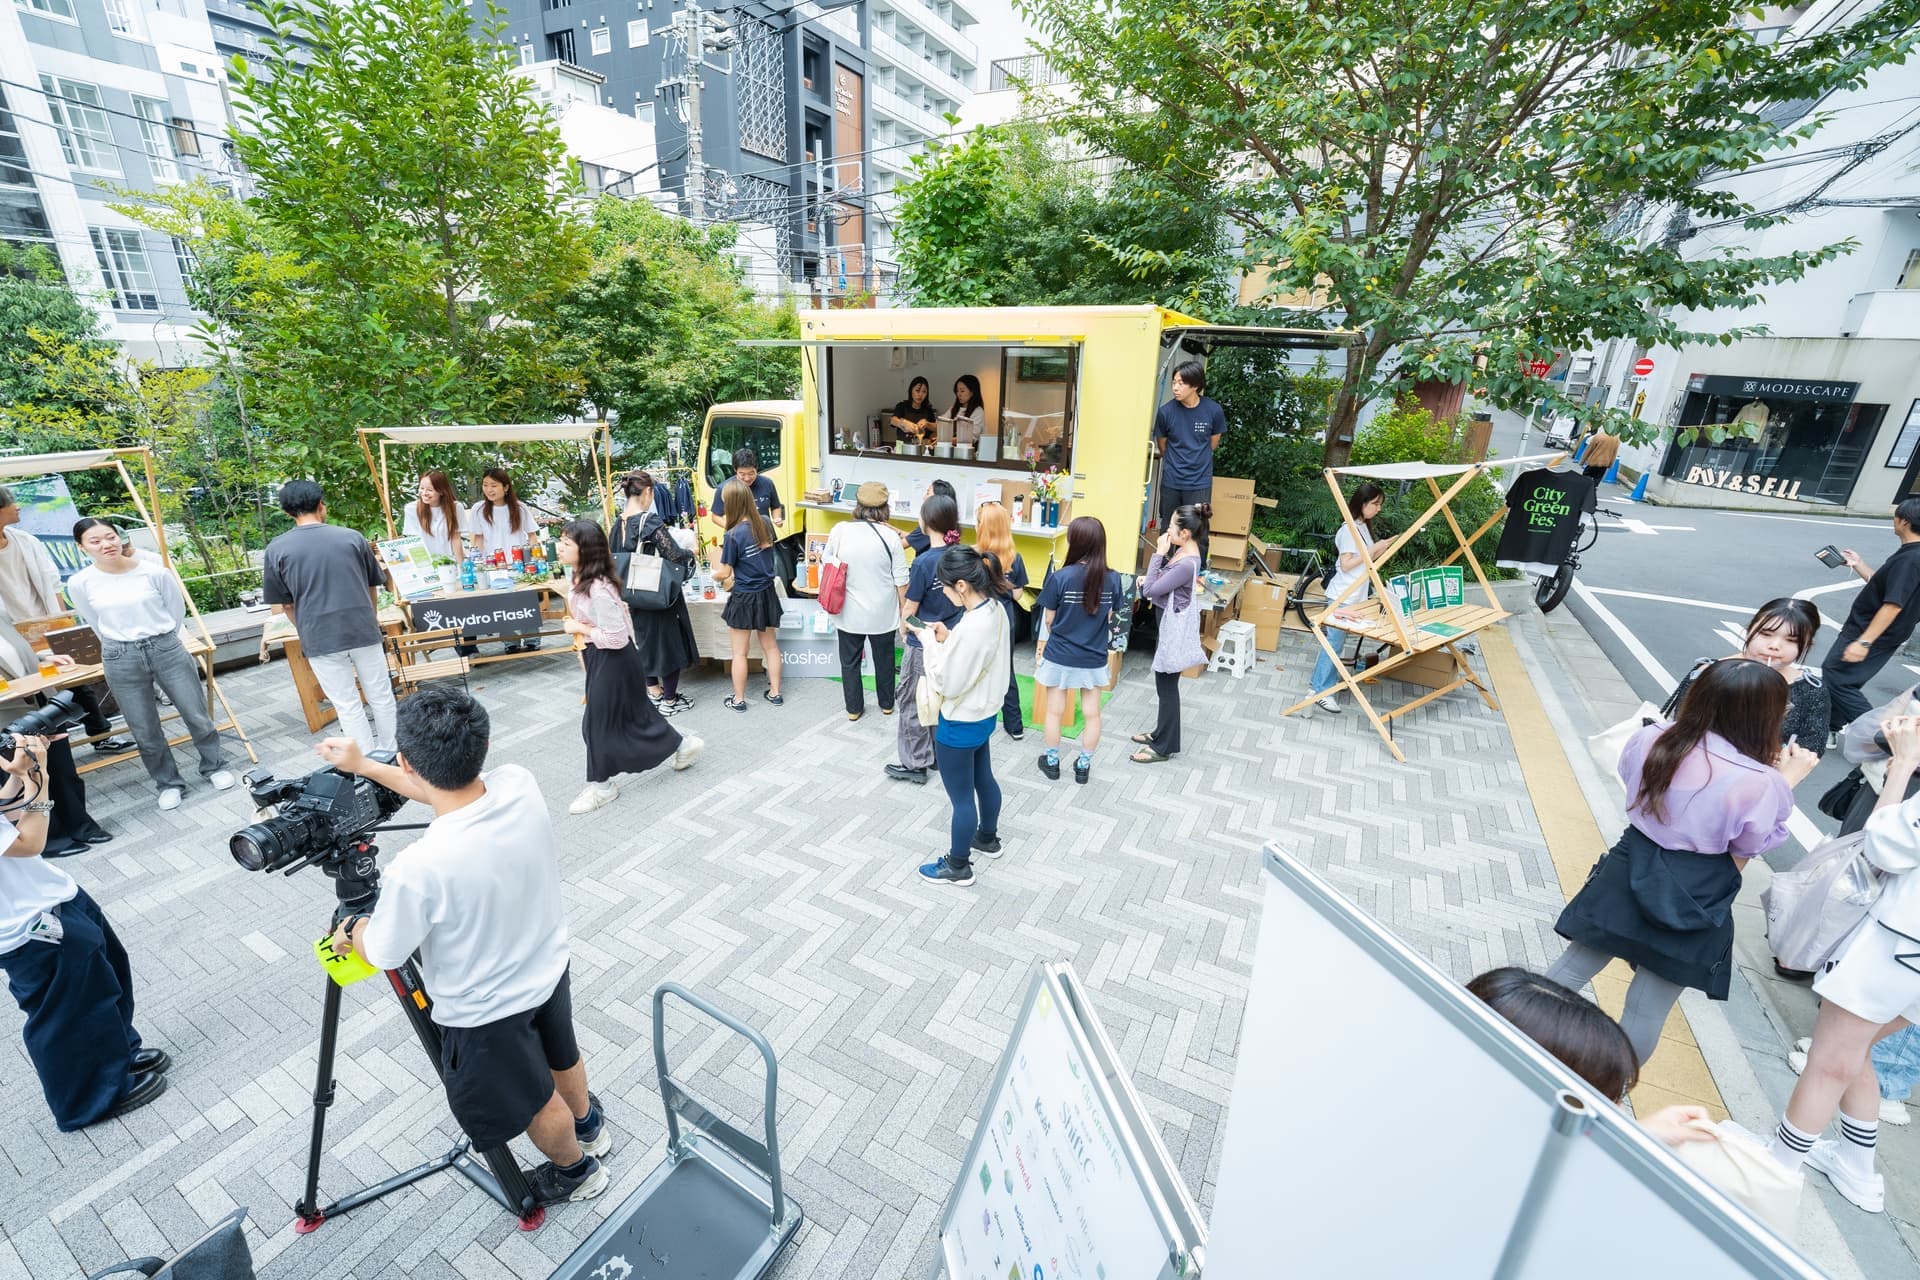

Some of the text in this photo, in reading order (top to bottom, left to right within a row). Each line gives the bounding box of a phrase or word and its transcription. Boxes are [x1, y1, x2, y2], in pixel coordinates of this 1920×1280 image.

[1758, 383, 1850, 397] MODESCAPE
[1533, 487, 1566, 504] City
[1523, 499, 1570, 516] Green
[1528, 512, 1557, 527] Fes.
[445, 608, 534, 630] Hydro Flask
